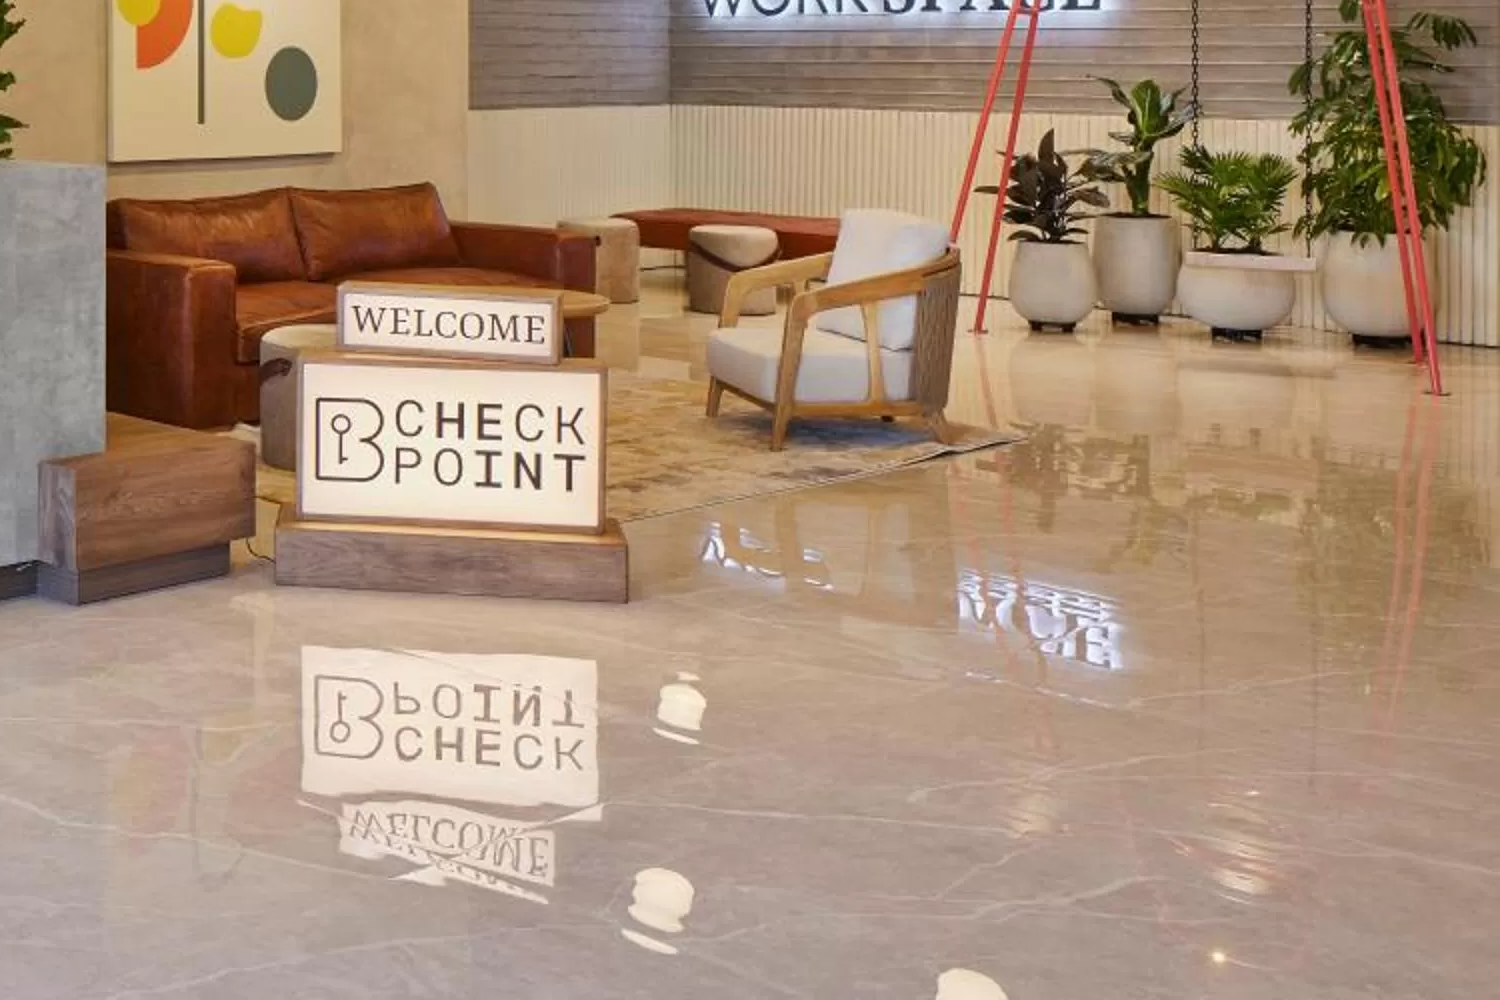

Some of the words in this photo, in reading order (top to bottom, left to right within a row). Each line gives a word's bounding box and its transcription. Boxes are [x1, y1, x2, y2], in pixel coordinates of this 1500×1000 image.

[352, 304, 546, 345] WELCOME
[395, 400, 585, 446] CHECK
[395, 446, 586, 492] POINT
